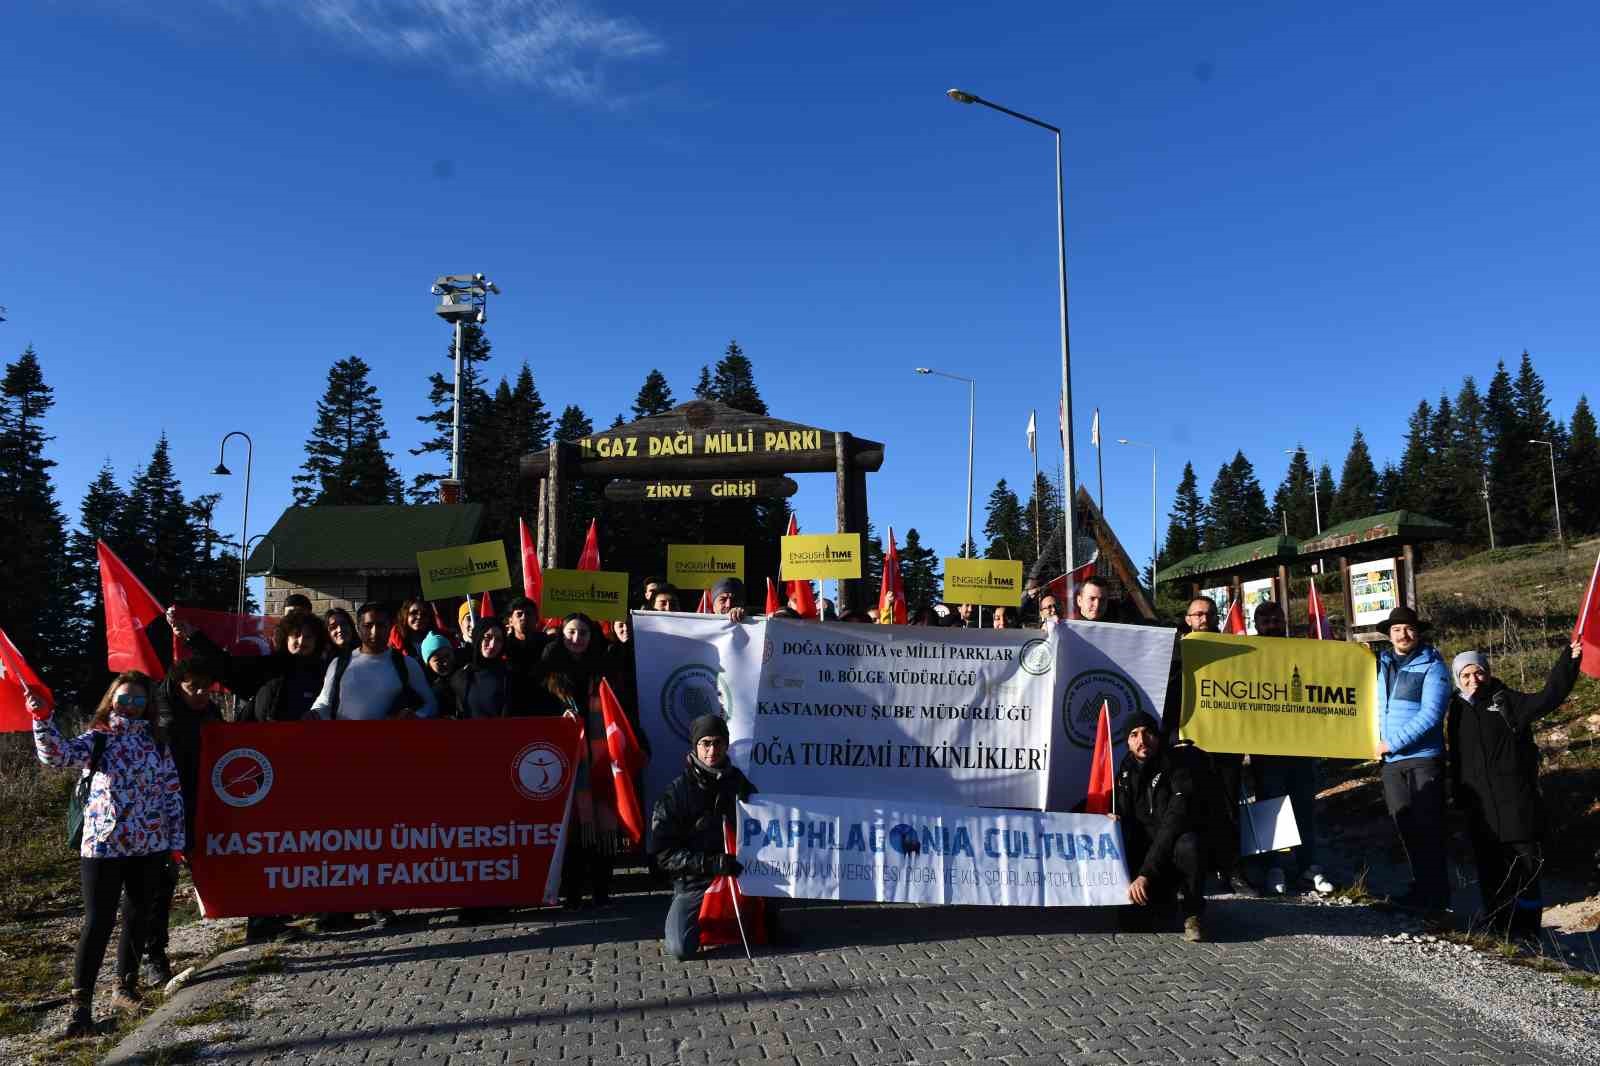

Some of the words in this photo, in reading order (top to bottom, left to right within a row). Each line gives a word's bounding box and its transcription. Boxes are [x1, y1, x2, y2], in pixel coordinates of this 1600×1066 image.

[580, 437, 638, 458] ILGAZ
[649, 431, 693, 456] DAĞI
[704, 429, 754, 454] MİLLİ
[765, 431, 821, 451] PARKI
[646, 482, 692, 498] ZİRVE
[711, 480, 757, 497] GİRİŞİ
[475, 559, 499, 570] TIME
[715, 562, 736, 570] TIME
[789, 551, 825, 561] ENGLISH
[831, 551, 852, 559] TIME
[952, 575, 987, 585] ENGLISH
[994, 578, 1014, 586] TIME
[593, 591, 620, 600] TIME
[783, 639, 822, 656] DOĞA
[825, 642, 888, 658] KORUMA
[890, 647, 903, 658] ve
[906, 640, 947, 659] MİLLİ
[950, 646, 1013, 662] PARKLAR
[817, 669, 835, 683] 10.
[838, 666, 886, 684] BÖLGE
[888, 668, 977, 687] MÜDÜRLÜĞÜ
[1201, 679, 1288, 701] ENGLISH
[1305, 685, 1357, 705] TIME
[757, 701, 867, 717] KASTAMONU
[872, 704, 915, 721] ŞUBE
[920, 705, 1032, 722] MÜDÜRLÜĞÜ
[1200, 701, 1212, 709] DİL
[1213, 702, 1237, 711] OKULU
[1238, 703, 1249, 711] VE
[800, 739, 892, 768] TURİZMİ
[899, 740, 1048, 771] ETKİNLİKLERİ
[206, 828, 383, 857] KASTAMONU
[984, 827, 1120, 861] CULTURA
[264, 861, 369, 890] TURİZM
[378, 854, 519, 885] FAKÜLTESİ
[744, 860, 817, 881] KASTAMONU
